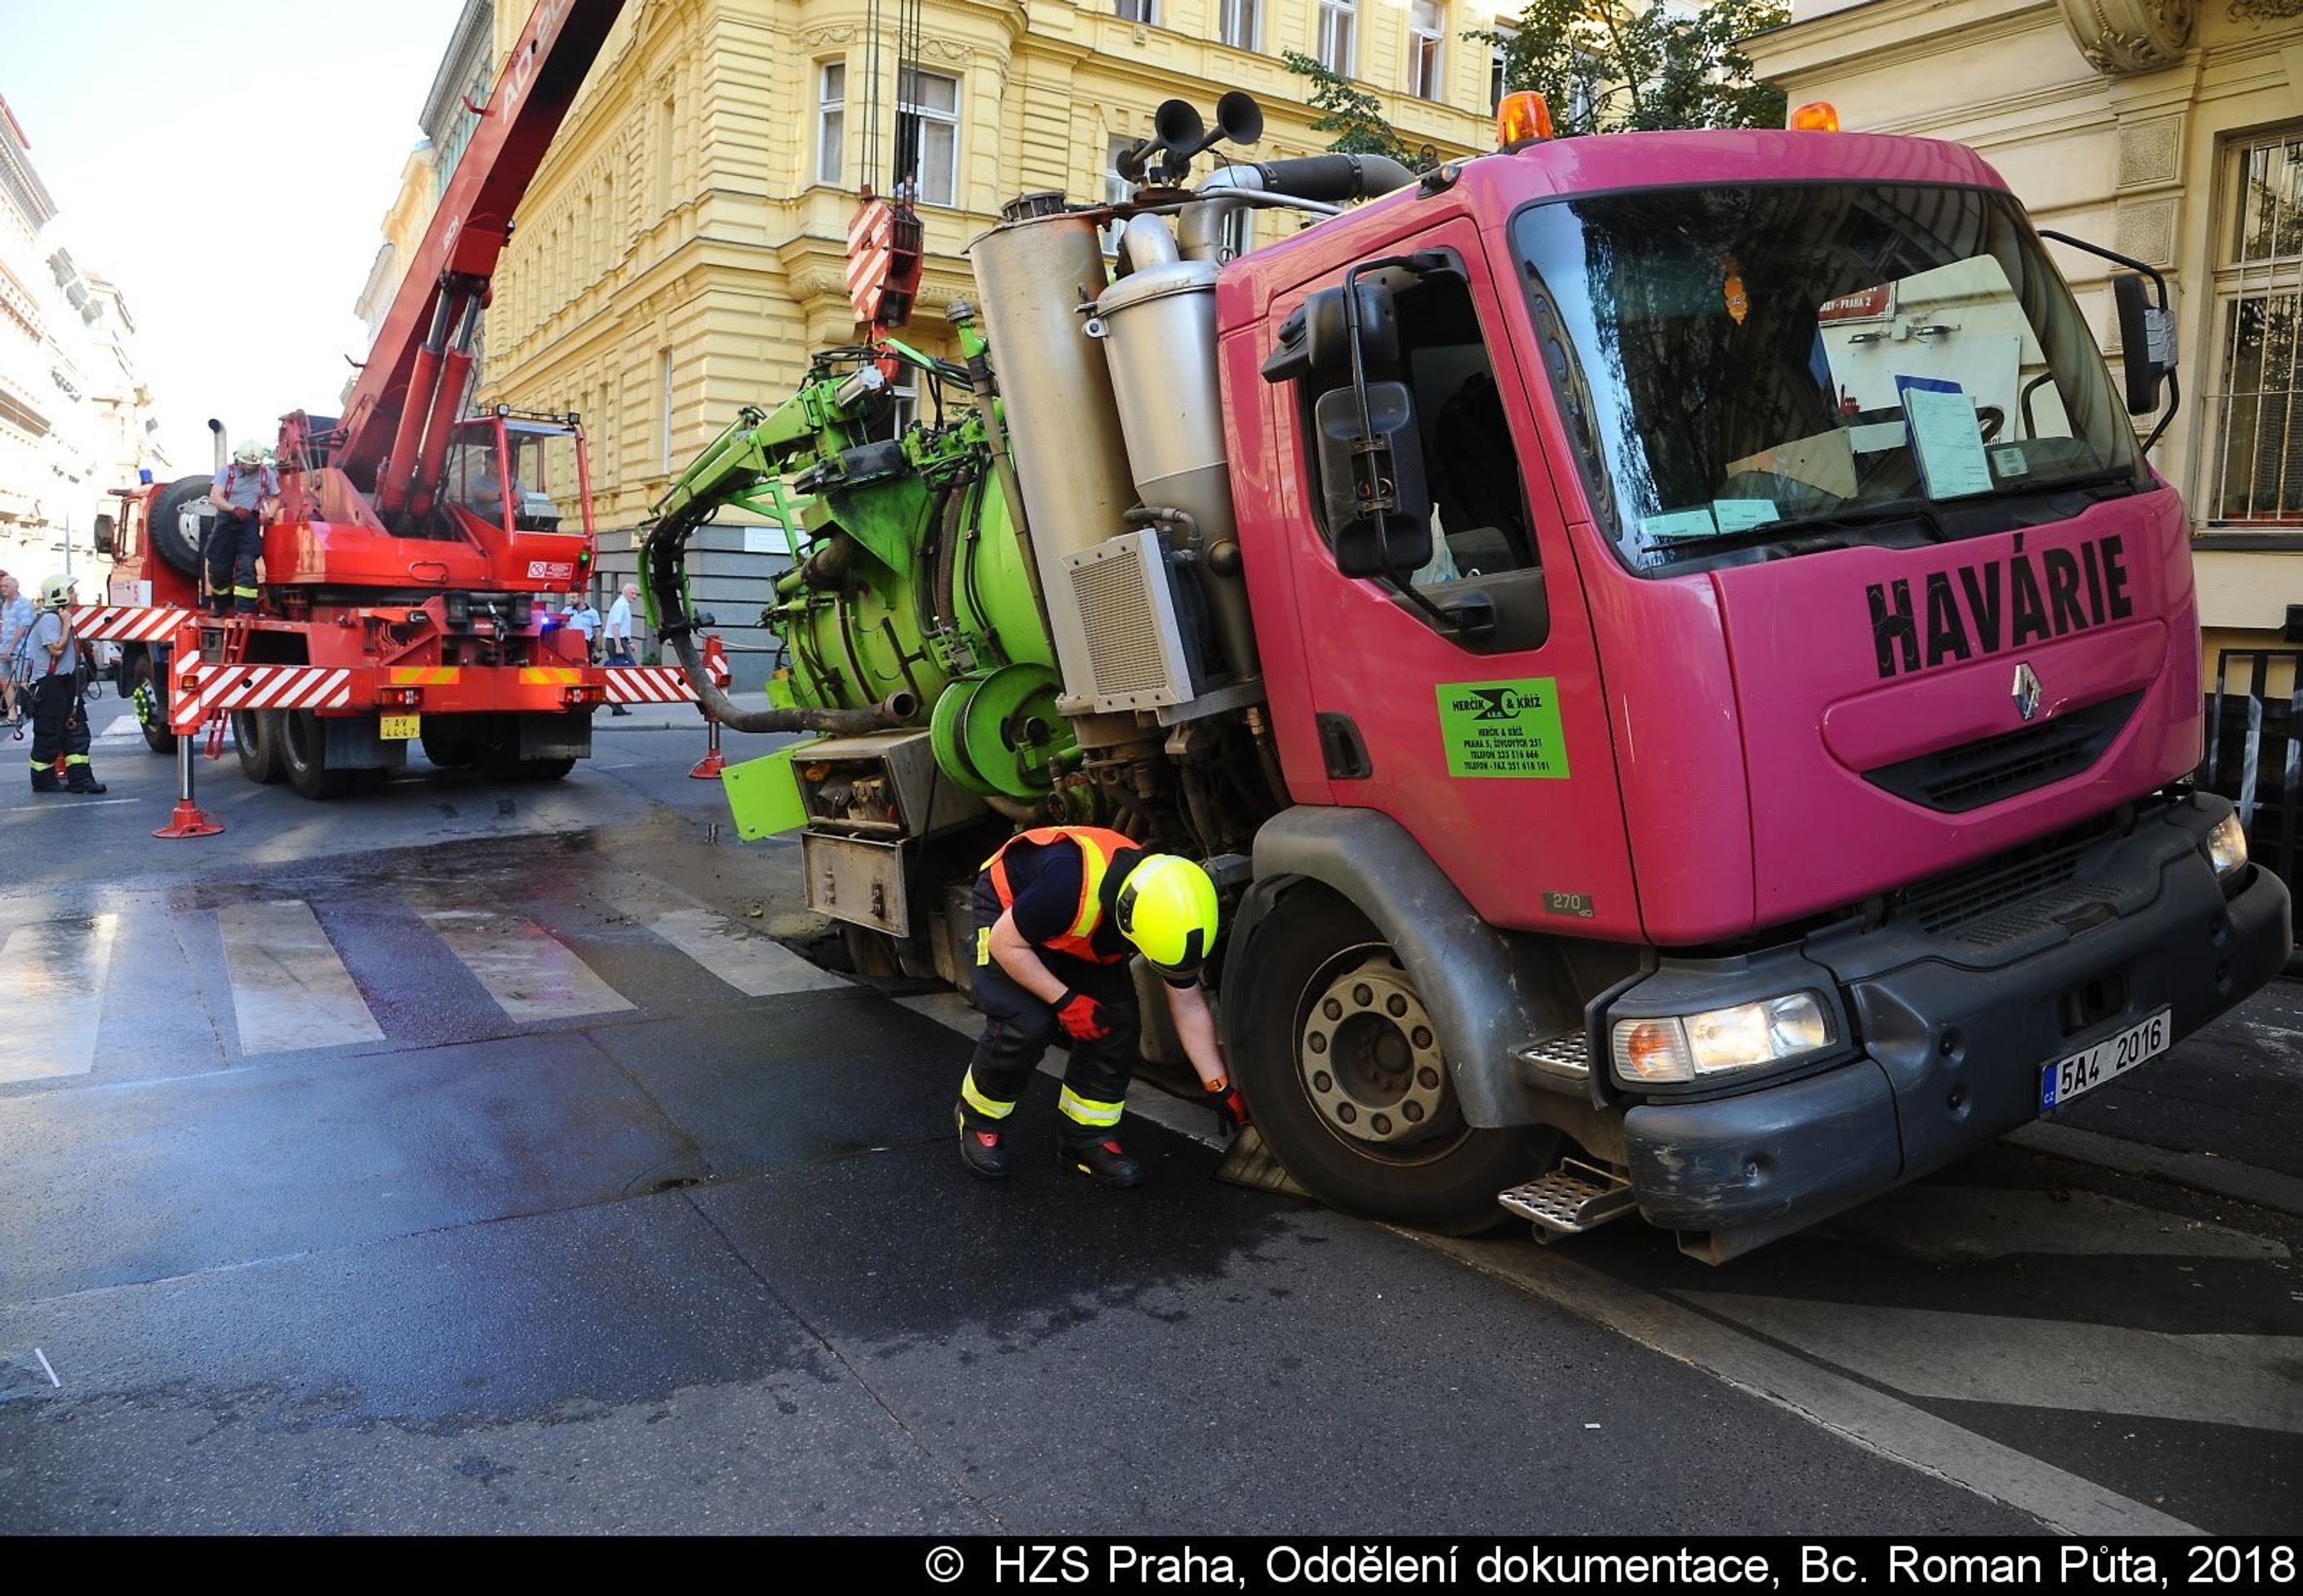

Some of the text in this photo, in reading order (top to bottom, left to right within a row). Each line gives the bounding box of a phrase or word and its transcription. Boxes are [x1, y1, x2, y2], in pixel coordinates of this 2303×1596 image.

[1841, 298, 1864, 309] PRAHA
[1866, 296, 1871, 307] 2
[1865, 532, 2133, 679] HAVÁRIE
[1452, 693, 1541, 712] HERČÍK & KŘÍŽ
[1463, 739, 1483, 748] PRAHA
[1471, 751, 1495, 759] TELEFON
[1464, 761, 1487, 770] TELEFON
[1494, 761, 1507, 770] FAX
[1553, 893, 1581, 909] 270
[2044, 1019, 2162, 1105] CZ 5A4 2016
